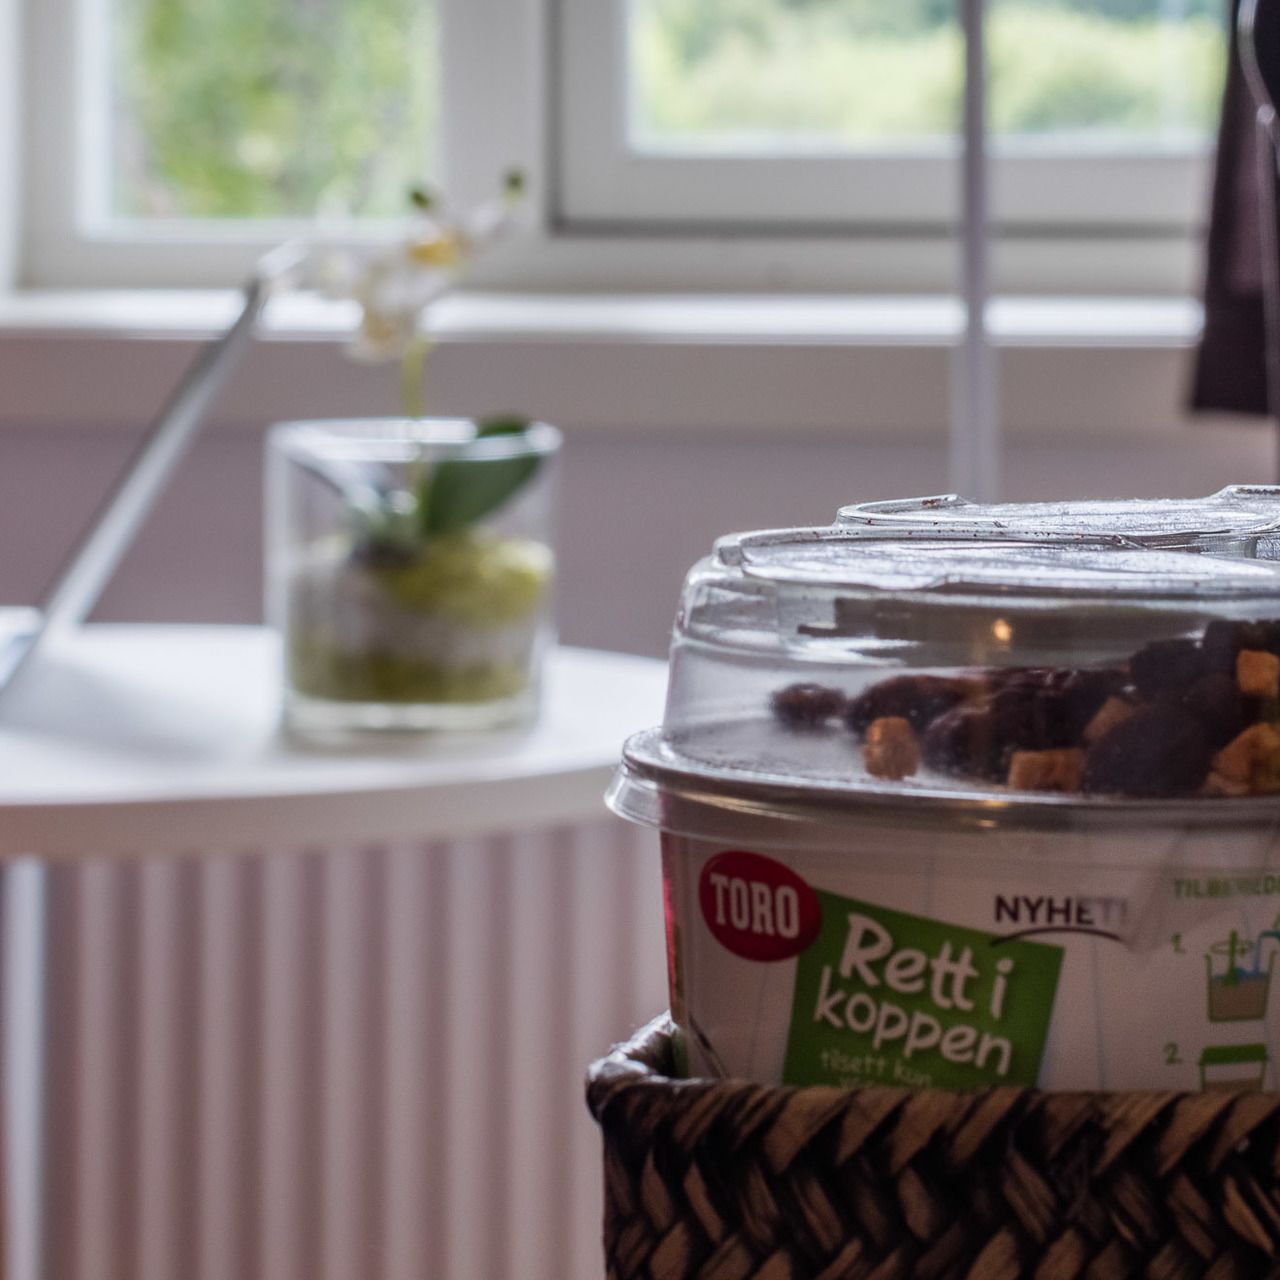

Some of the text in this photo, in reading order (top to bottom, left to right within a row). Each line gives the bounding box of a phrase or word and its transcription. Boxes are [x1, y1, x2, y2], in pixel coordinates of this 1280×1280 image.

[710, 873, 800, 939] TORO
[839, 912, 1014, 1019] Rett i
[815, 966, 1012, 1077] koppen
